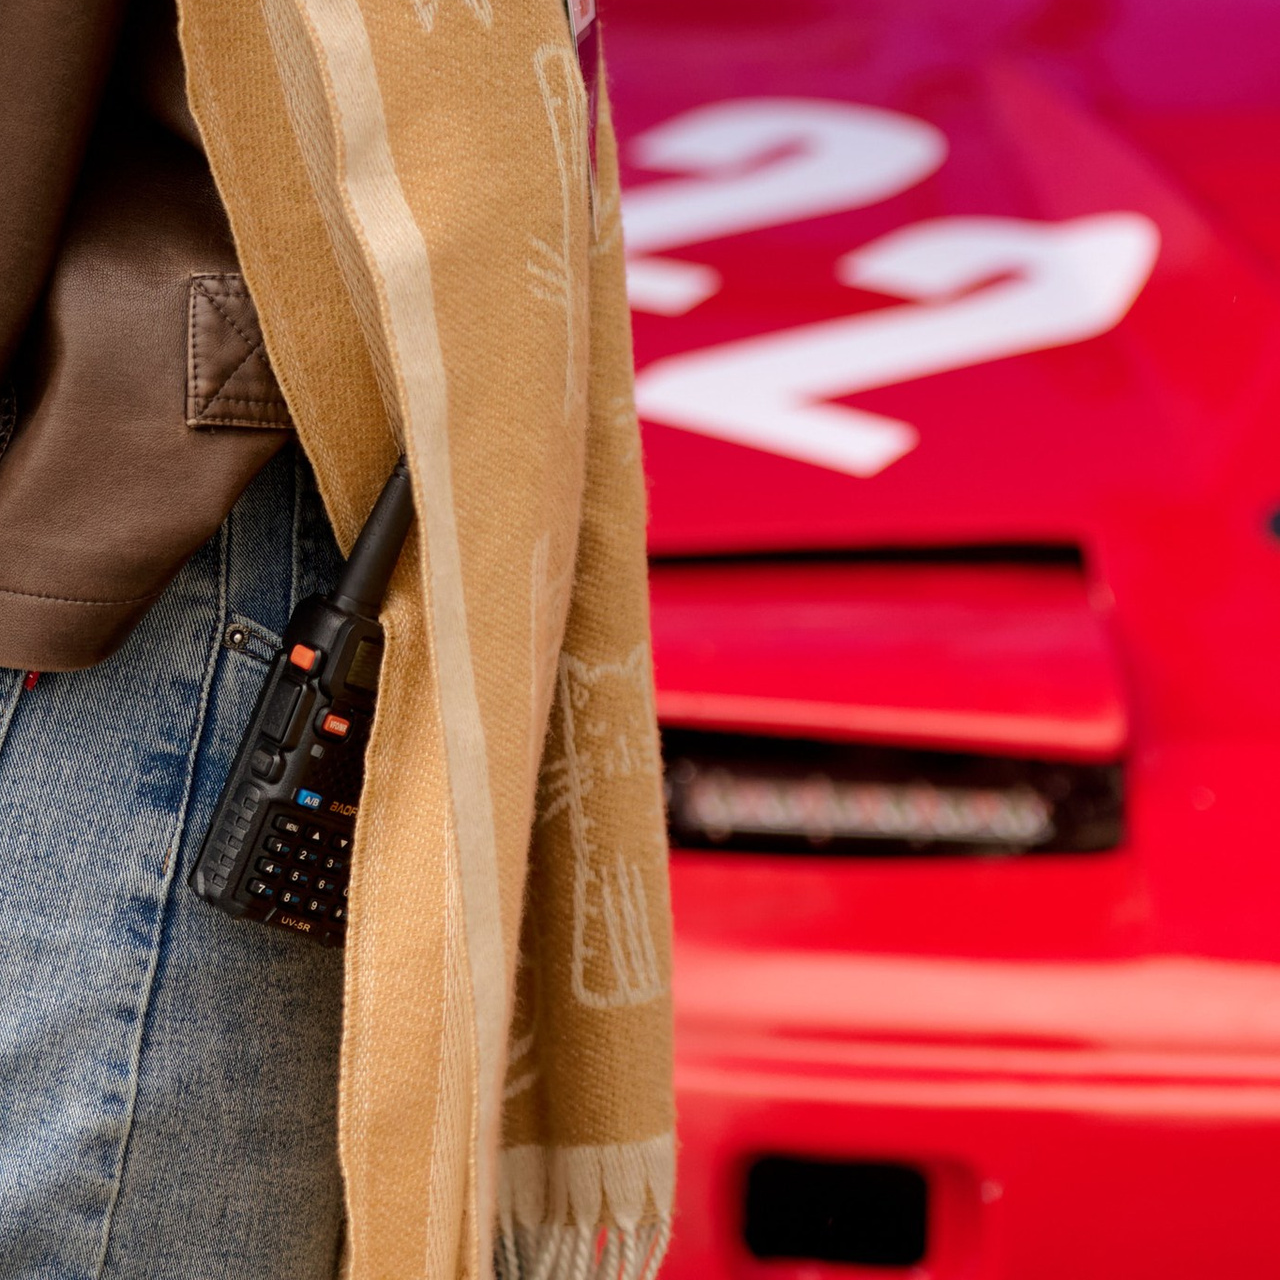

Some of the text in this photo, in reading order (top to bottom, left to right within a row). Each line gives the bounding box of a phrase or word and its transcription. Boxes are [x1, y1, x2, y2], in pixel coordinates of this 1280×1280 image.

[304, 795, 320, 807] A/B
[285, 822, 299, 833] MENU
[276, 843, 282, 852] 1
[299, 850, 307, 860] 2
[327, 859, 334, 868] 3
[265, 864, 274, 873] 4
[291, 871, 300, 881] 5
[318, 880, 326, 889] 6
[258, 884, 266, 893] 7
[283, 893, 291, 903] 8
[310, 901, 318, 911] 9
[281, 916, 311, 933] UV-5R
